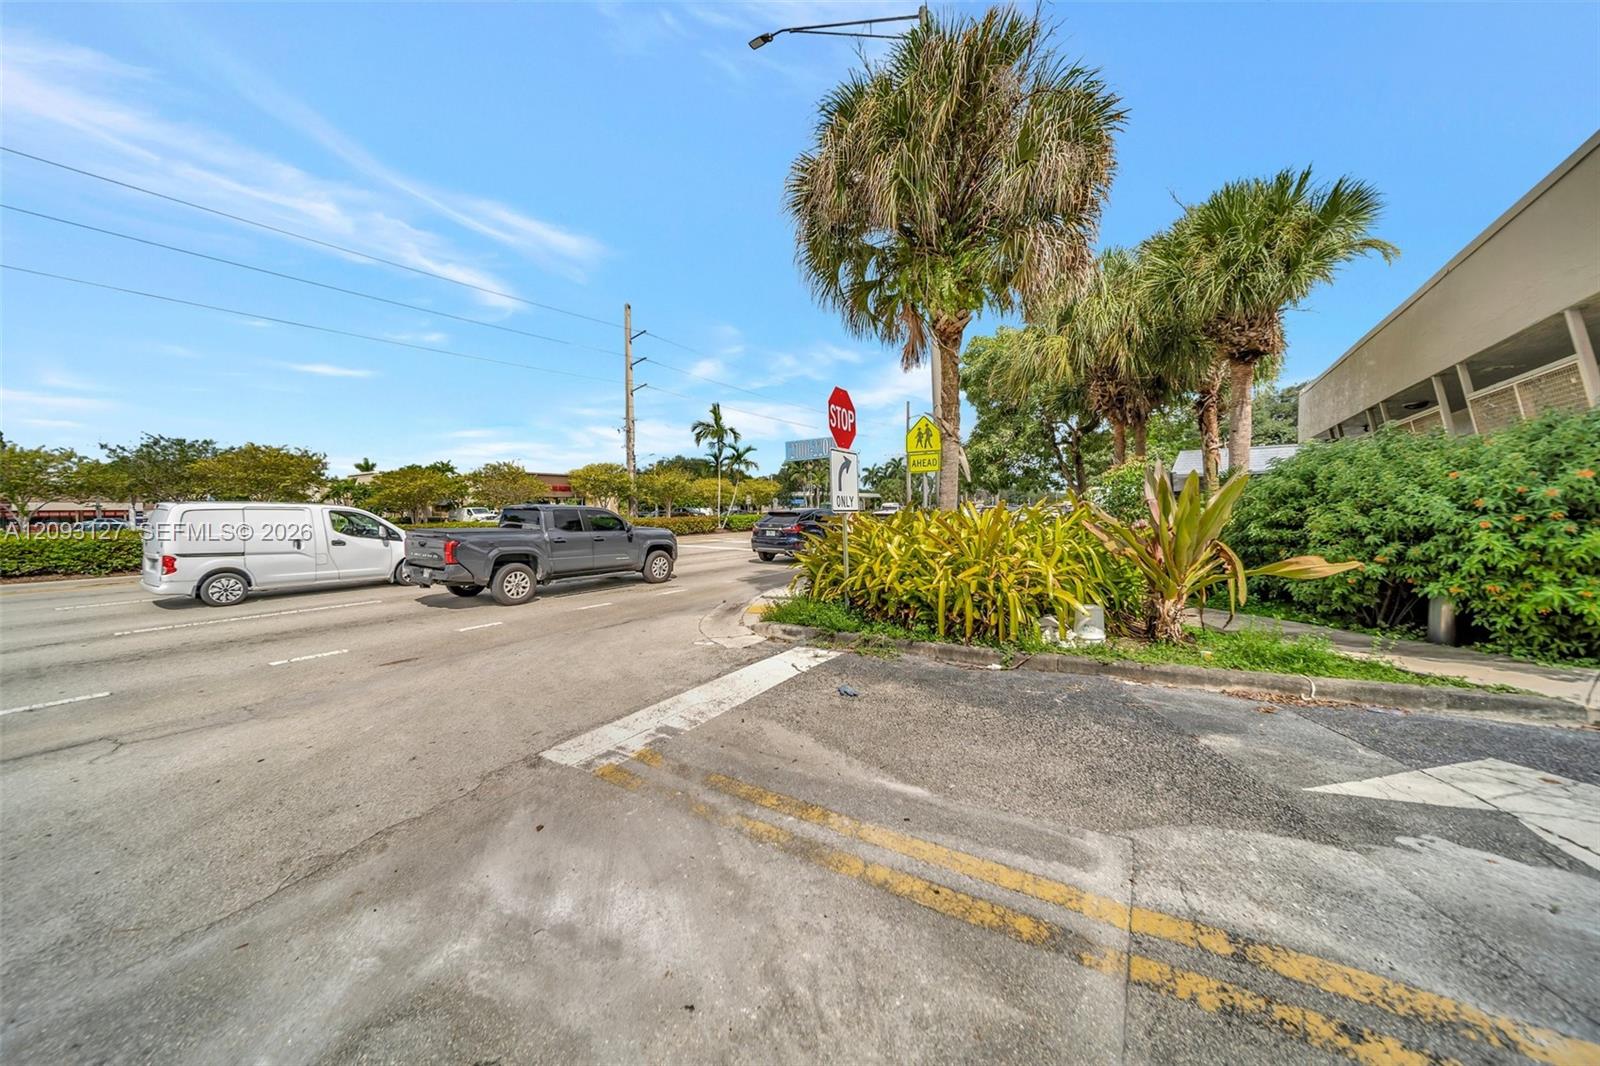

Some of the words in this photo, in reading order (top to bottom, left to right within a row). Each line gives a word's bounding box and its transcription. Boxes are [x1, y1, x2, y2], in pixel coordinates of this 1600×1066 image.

[829, 404, 855, 432] STOP
[911, 458, 938, 468] AHEAD
[836, 495, 855, 508] ONLY
